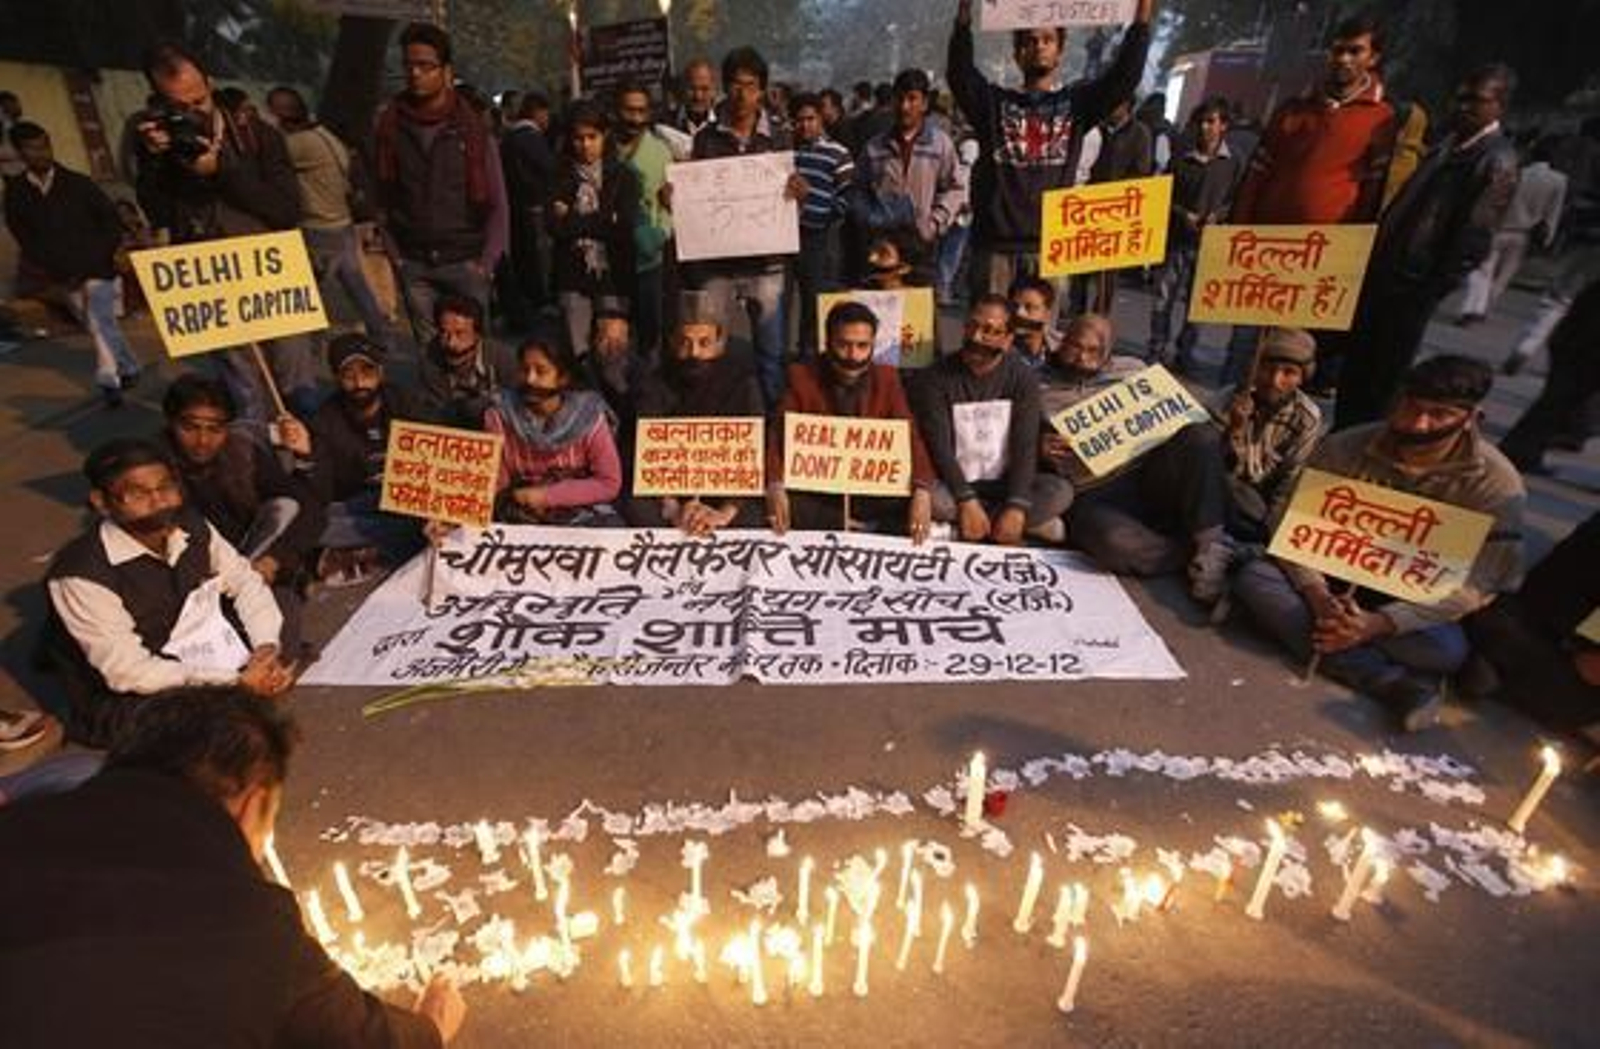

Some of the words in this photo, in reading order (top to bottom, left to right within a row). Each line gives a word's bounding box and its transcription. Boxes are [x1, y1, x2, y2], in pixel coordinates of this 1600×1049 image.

[1060, 187, 1143, 228] दिल्ली
[152, 252, 243, 293] DELHI
[253, 246, 283, 277] IS
[1229, 230, 1330, 273] दिल्ली
[164, 299, 229, 337] RAPE
[238, 287, 319, 323] CAPITAL
[1064, 391, 1125, 435] DELHI
[1127, 378, 1153, 402] IS
[1078, 425, 1123, 459] RAPE
[1124, 393, 1192, 437] CAPITAL
[794, 422, 838, 448] REAL
[844, 426, 895, 451] MAN
[790, 451, 842, 480] DONT
[847, 457, 900, 483] RAPE
[1320, 486, 1442, 546] दिल्ली
[789, 533, 957, 583] सोसायटी
[848, 606, 1005, 646] मार्च
[944, 653, 1083, 675] 29-12-12
